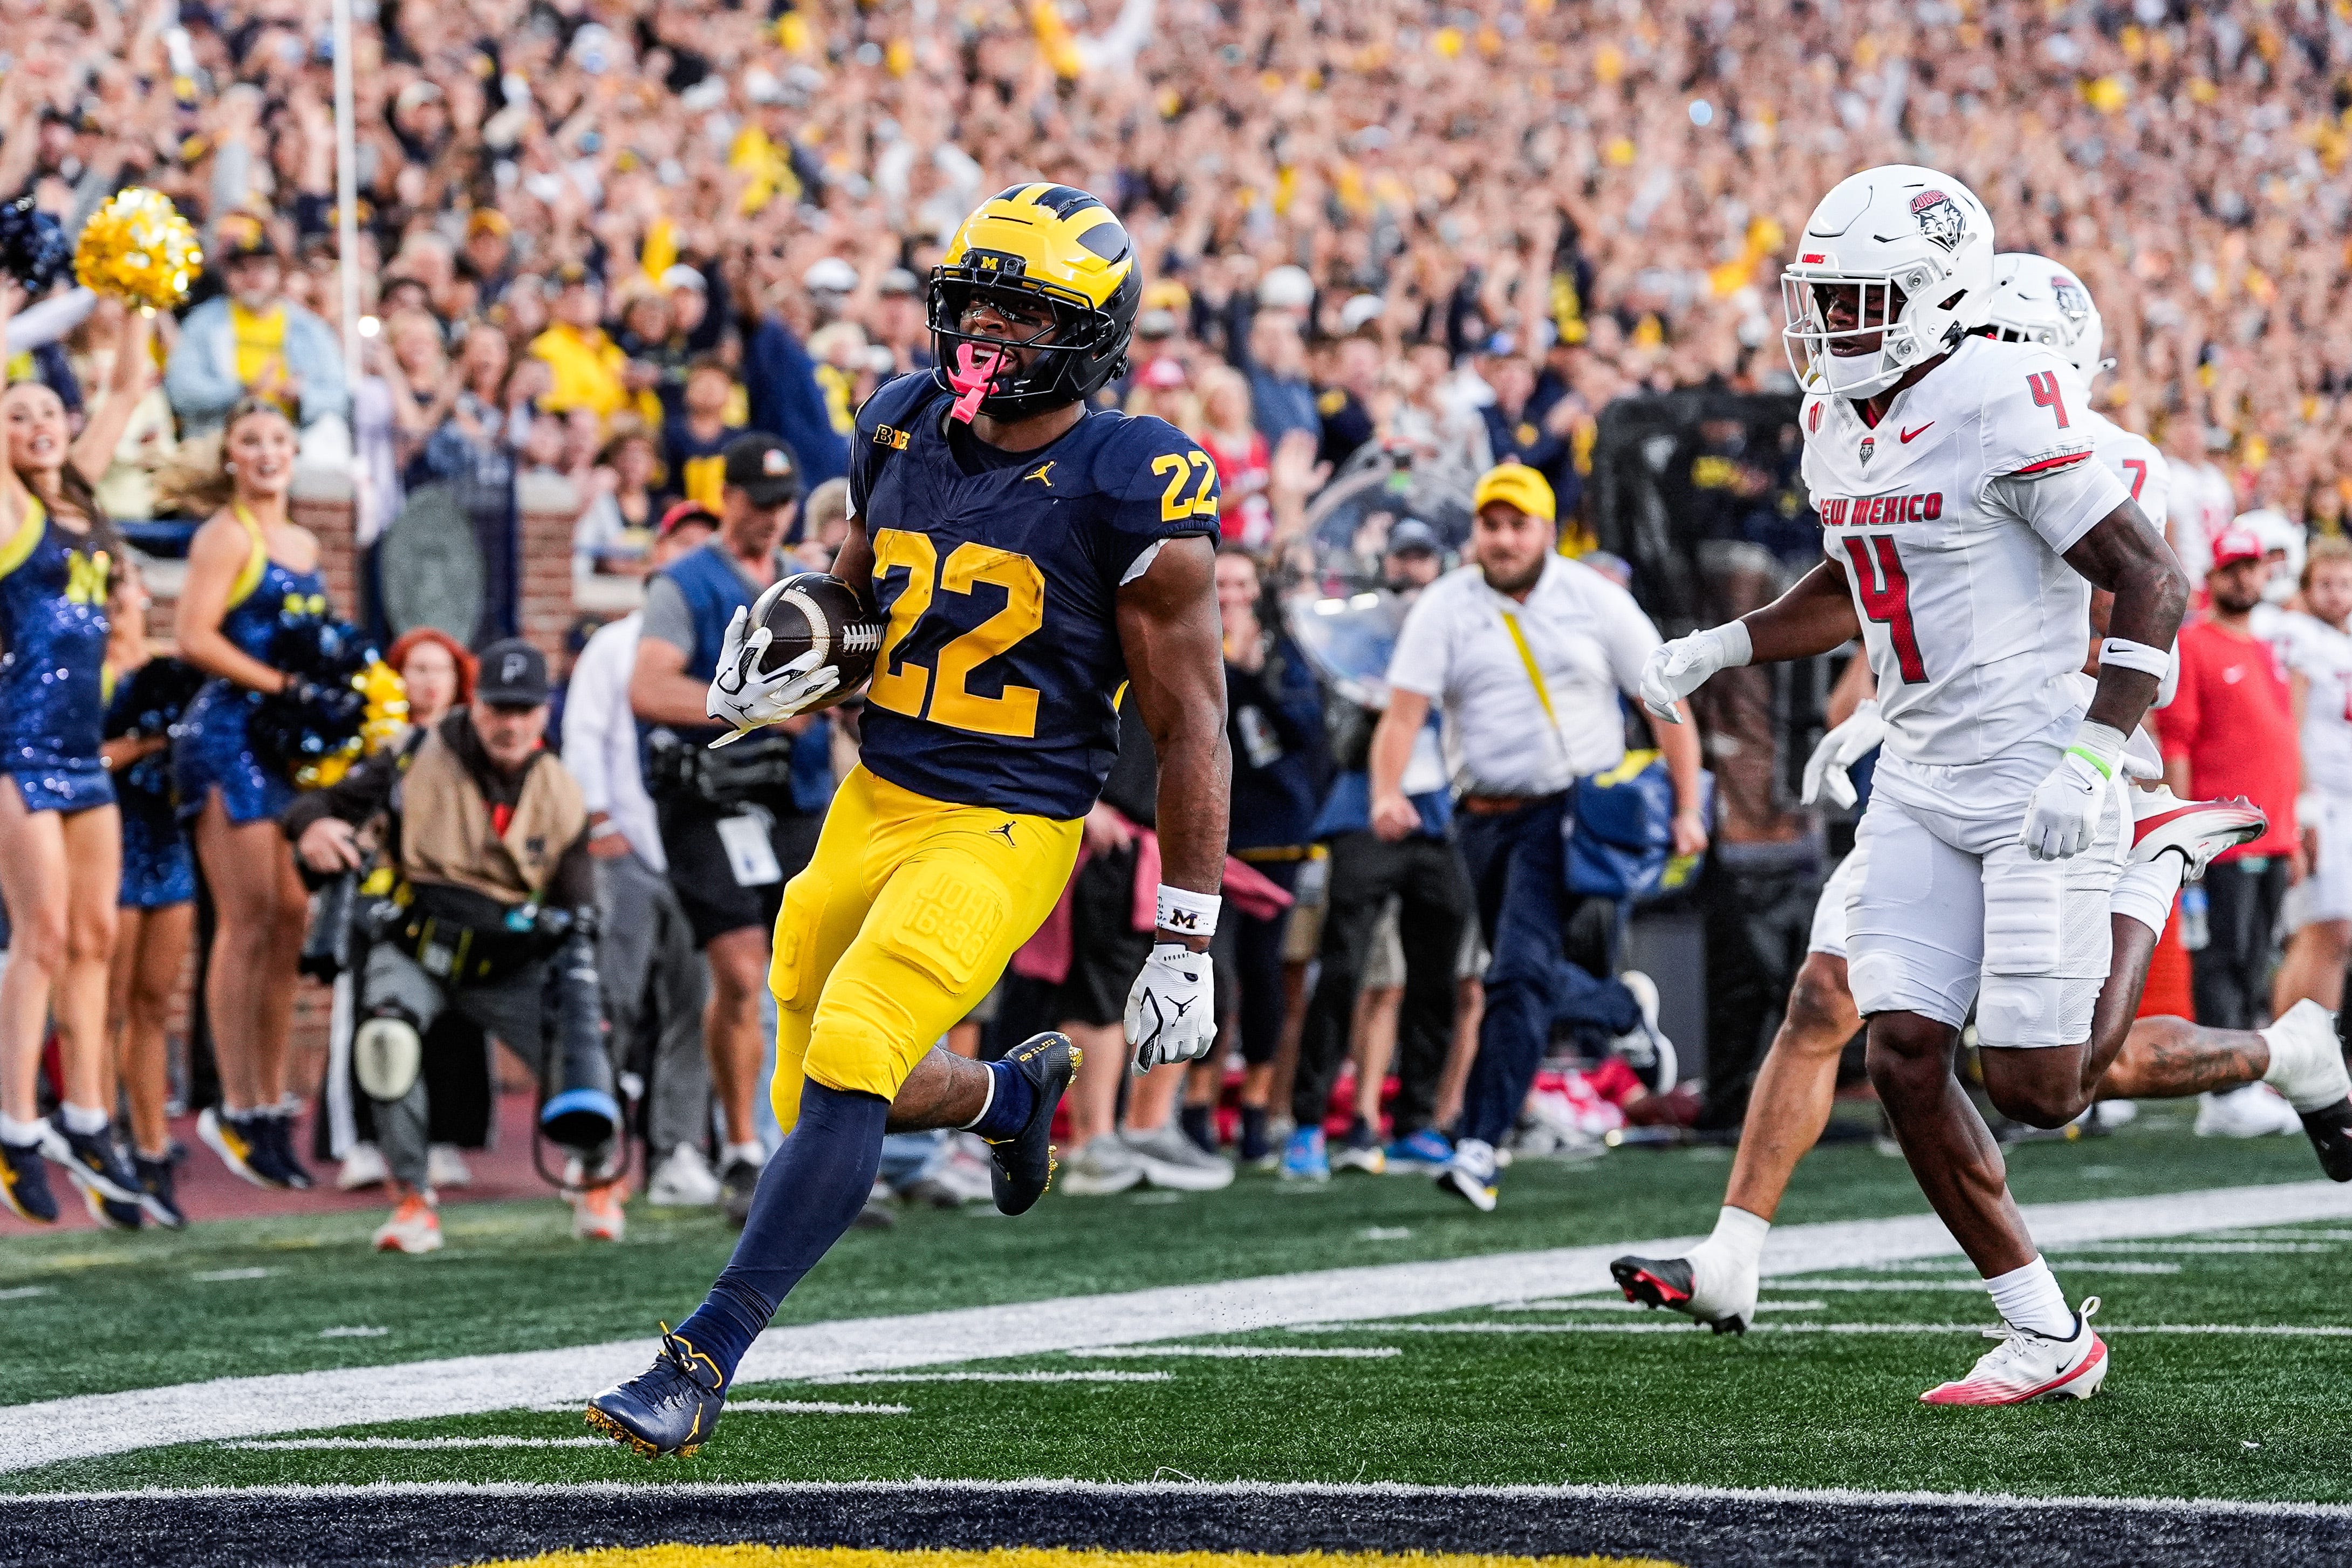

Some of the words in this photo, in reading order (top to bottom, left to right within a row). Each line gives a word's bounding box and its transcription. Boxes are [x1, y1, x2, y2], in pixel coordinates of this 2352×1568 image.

[1910, 190, 1948, 214] LOBOS
[980, 256, 999, 270] M
[2026, 370, 2070, 429] 4
[1151, 450, 1218, 523] 22
[1851, 491, 1943, 526] MEXICO
[2123, 460, 2147, 502] 7
[866, 527, 1045, 738] 22
[1841, 534, 1930, 685] 4
[902, 898, 986, 969] 16:33
[918, 872, 1003, 941] JOHN
[1170, 908, 1198, 929] M
